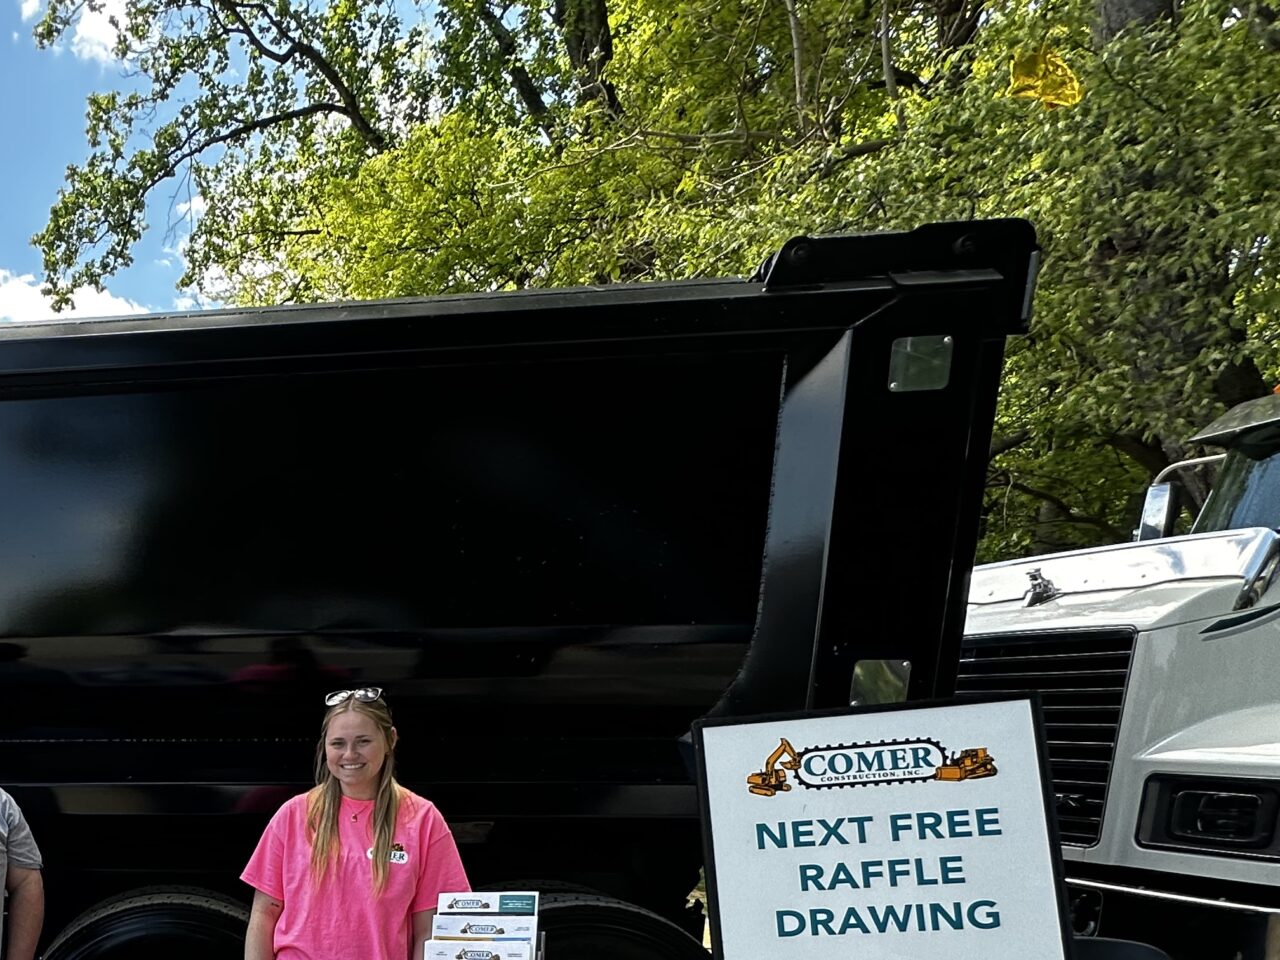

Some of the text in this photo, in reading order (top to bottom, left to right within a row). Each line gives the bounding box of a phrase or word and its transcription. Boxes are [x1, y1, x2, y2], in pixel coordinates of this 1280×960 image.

[803, 746, 936, 777] COMER
[902, 769, 924, 777] INC.
[756, 808, 1002, 849] NEXT FREE
[799, 856, 966, 891] RAFFLE
[775, 900, 1001, 937] DRAWING
